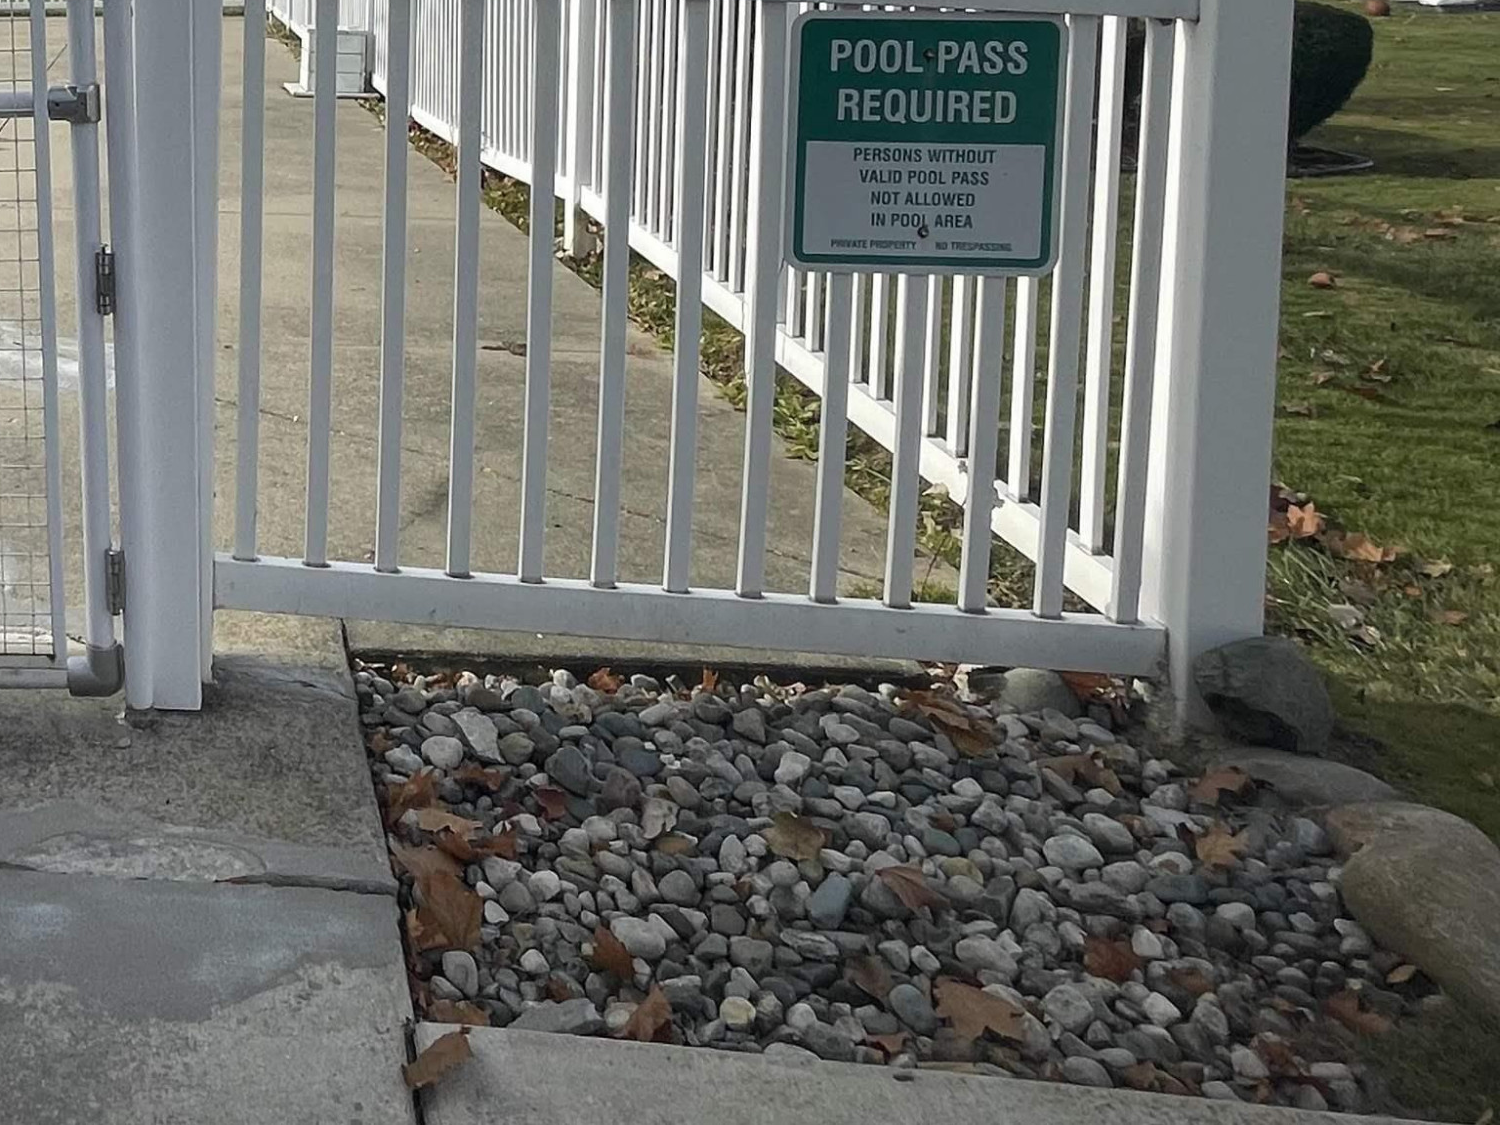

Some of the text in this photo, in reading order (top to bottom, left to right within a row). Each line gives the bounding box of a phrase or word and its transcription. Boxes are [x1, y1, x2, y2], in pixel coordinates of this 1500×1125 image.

[830, 39, 1029, 75] POOL PASS
[836, 88, 1018, 125] REQUIRED
[853, 147, 997, 164] PERSONS WITHOUT
[859, 170, 990, 186] VALID POOL PASS
[870, 191, 976, 207] NOT ALLOWED
[870, 213, 973, 229] IN POOL AREA
[830, 238, 917, 250] PRIVATE PROPERTY
